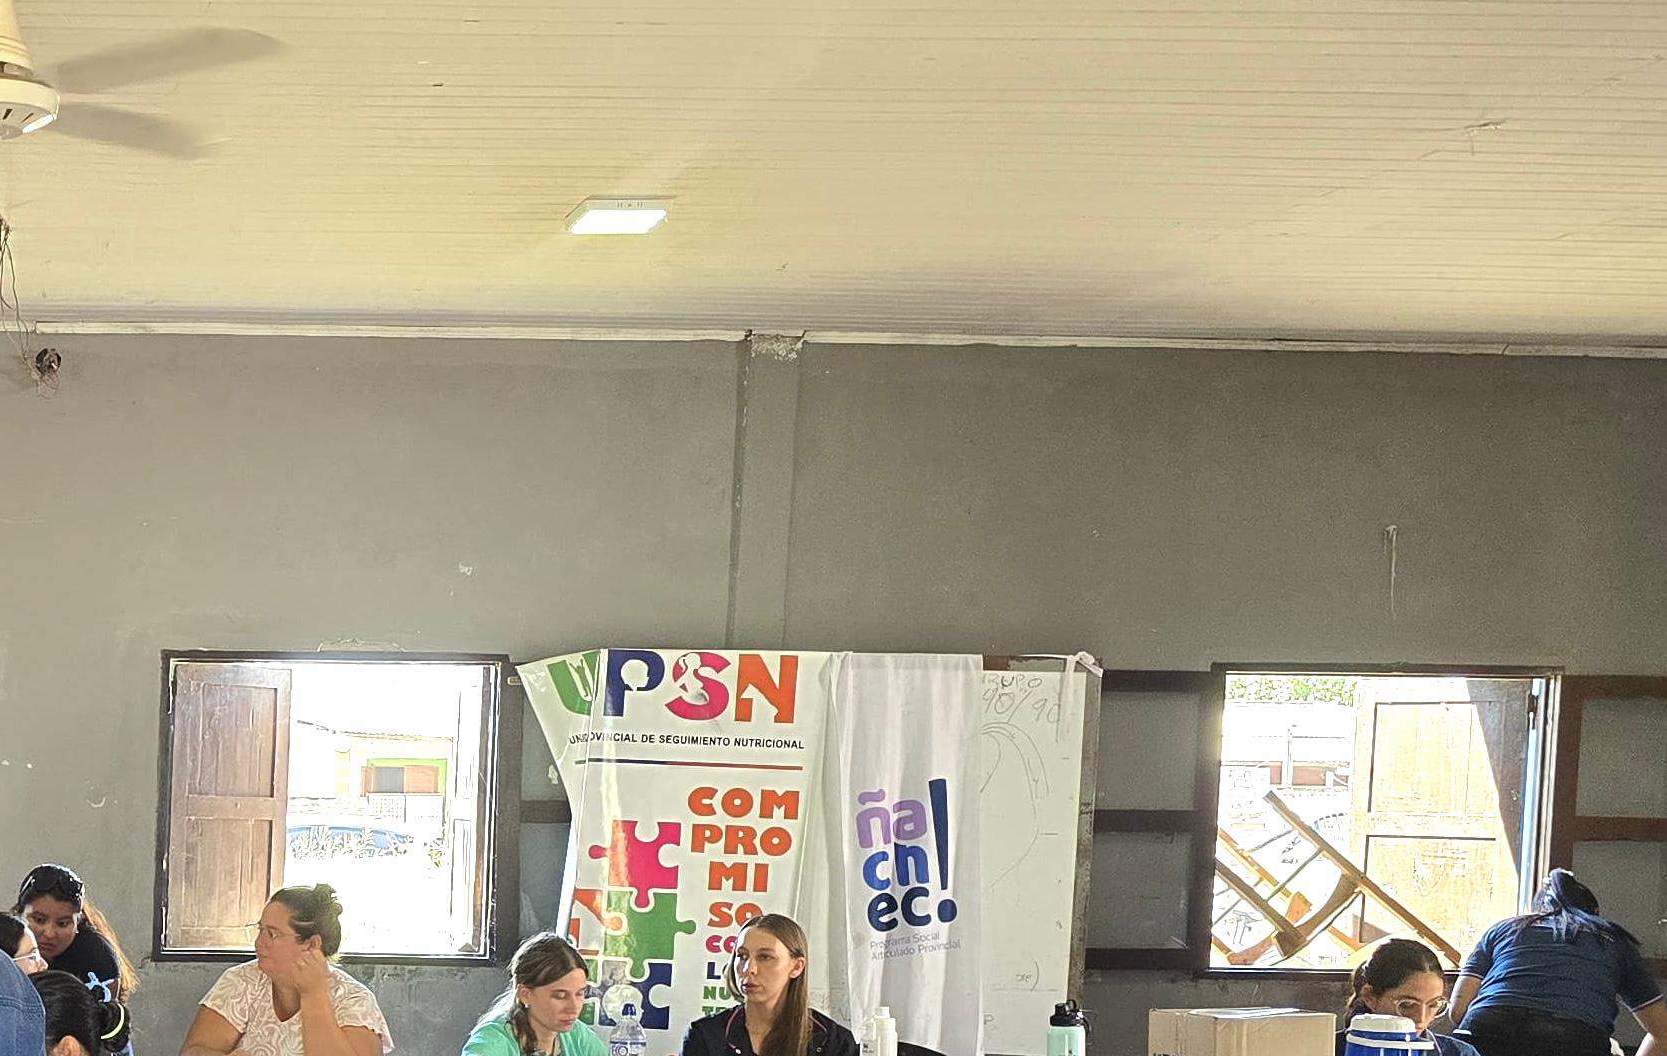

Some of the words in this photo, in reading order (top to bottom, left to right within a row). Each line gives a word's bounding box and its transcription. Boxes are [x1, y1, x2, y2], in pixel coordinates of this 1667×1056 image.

[547, 648, 798, 725] UPSN
[641, 734, 655, 744] DE
[659, 735, 731, 747] SEGUIMIENTO
[733, 737, 805, 750] NUTRICIONAL
[688, 787, 800, 820] COM
[691, 823, 792, 857] PRO
[708, 861, 769, 893] MI
[707, 901, 764, 928] SO
